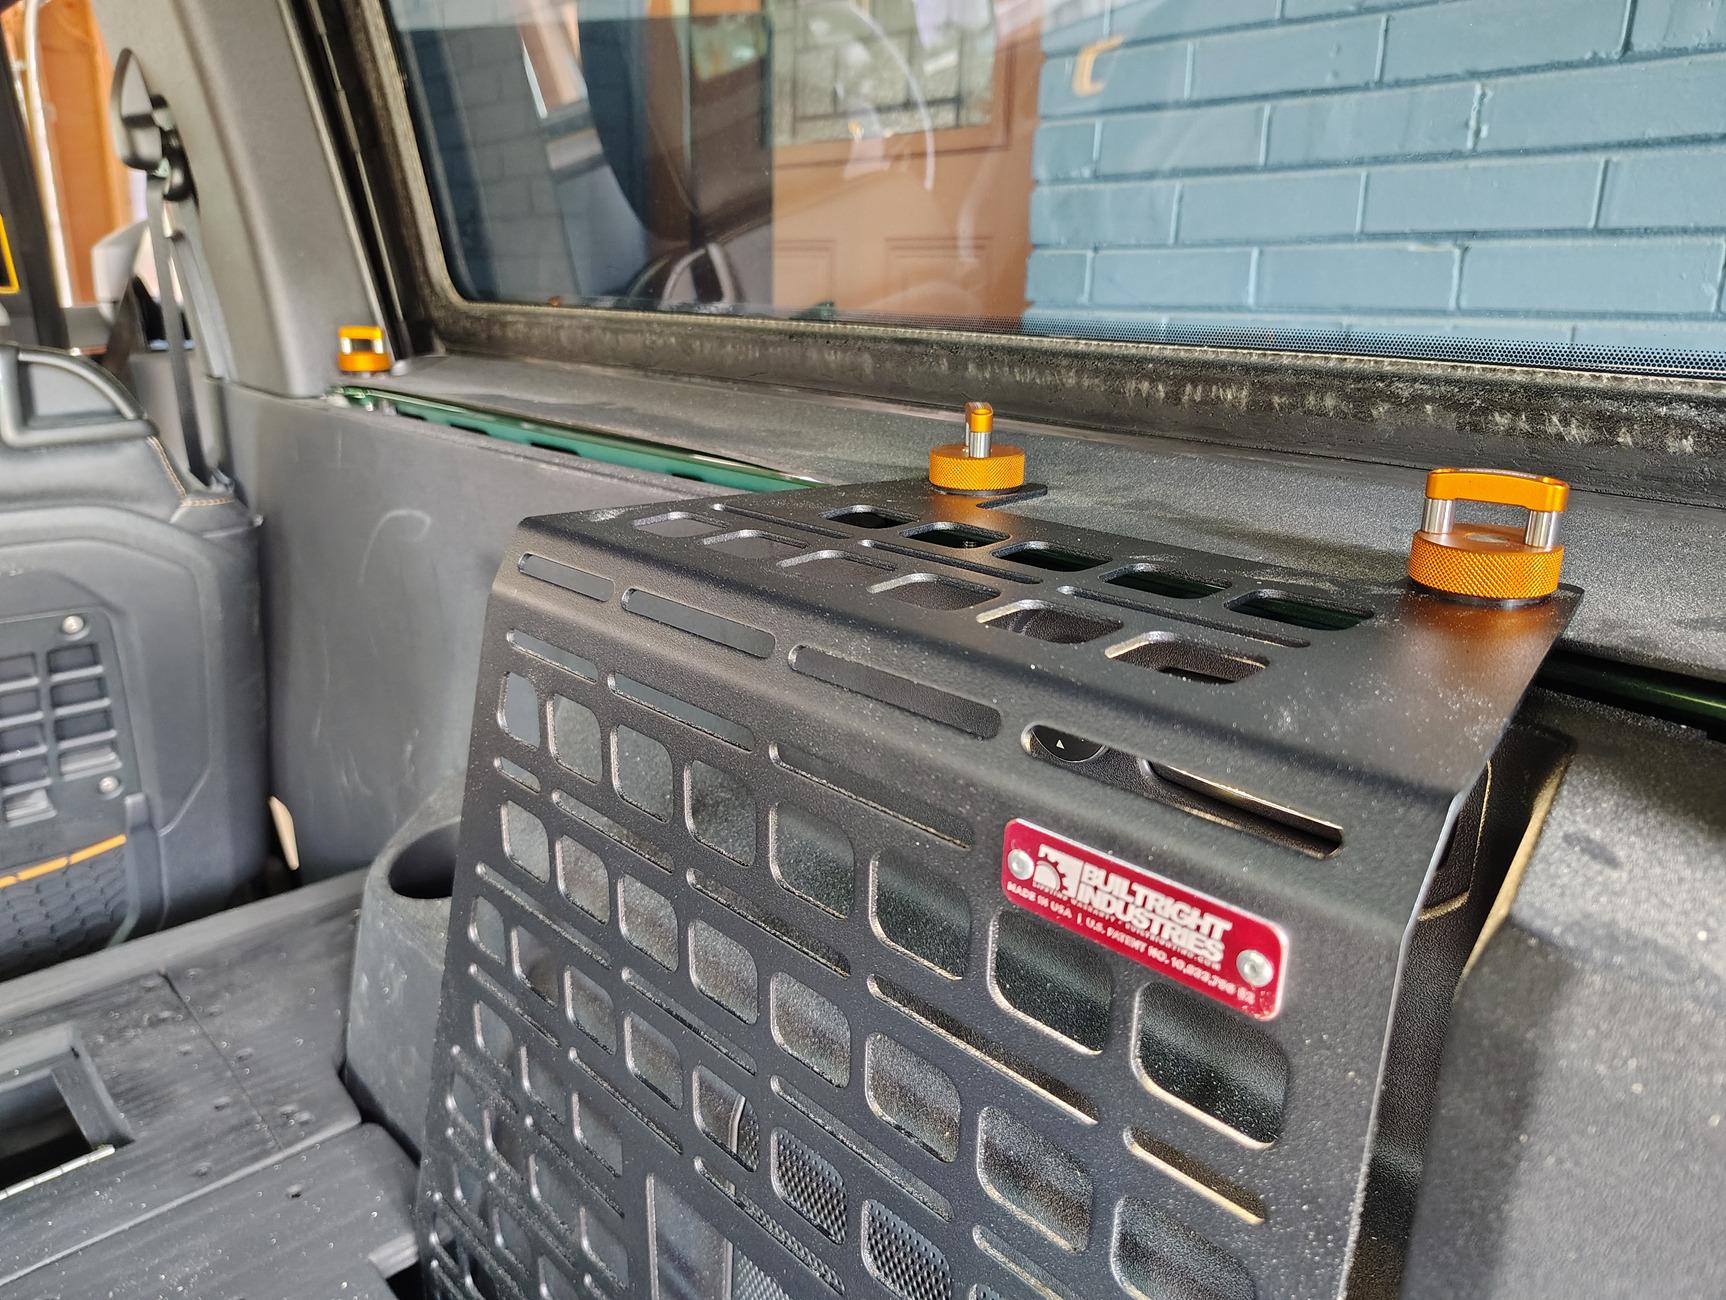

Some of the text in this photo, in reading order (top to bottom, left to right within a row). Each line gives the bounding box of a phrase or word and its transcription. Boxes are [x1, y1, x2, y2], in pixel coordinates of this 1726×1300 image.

[1007, 881, 1036, 902] MADE
[1037, 895, 1049, 908] IN
[1050, 901, 1072, 919] USA
[1086, 916, 1106, 934] U.S.
[1106, 926, 1147, 953] PATENT
[1147, 945, 1170, 965] NO.
[1076, 883, 1225, 962] INDUSTRIES
[1080, 862, 1233, 941] BUILTRIGHT
